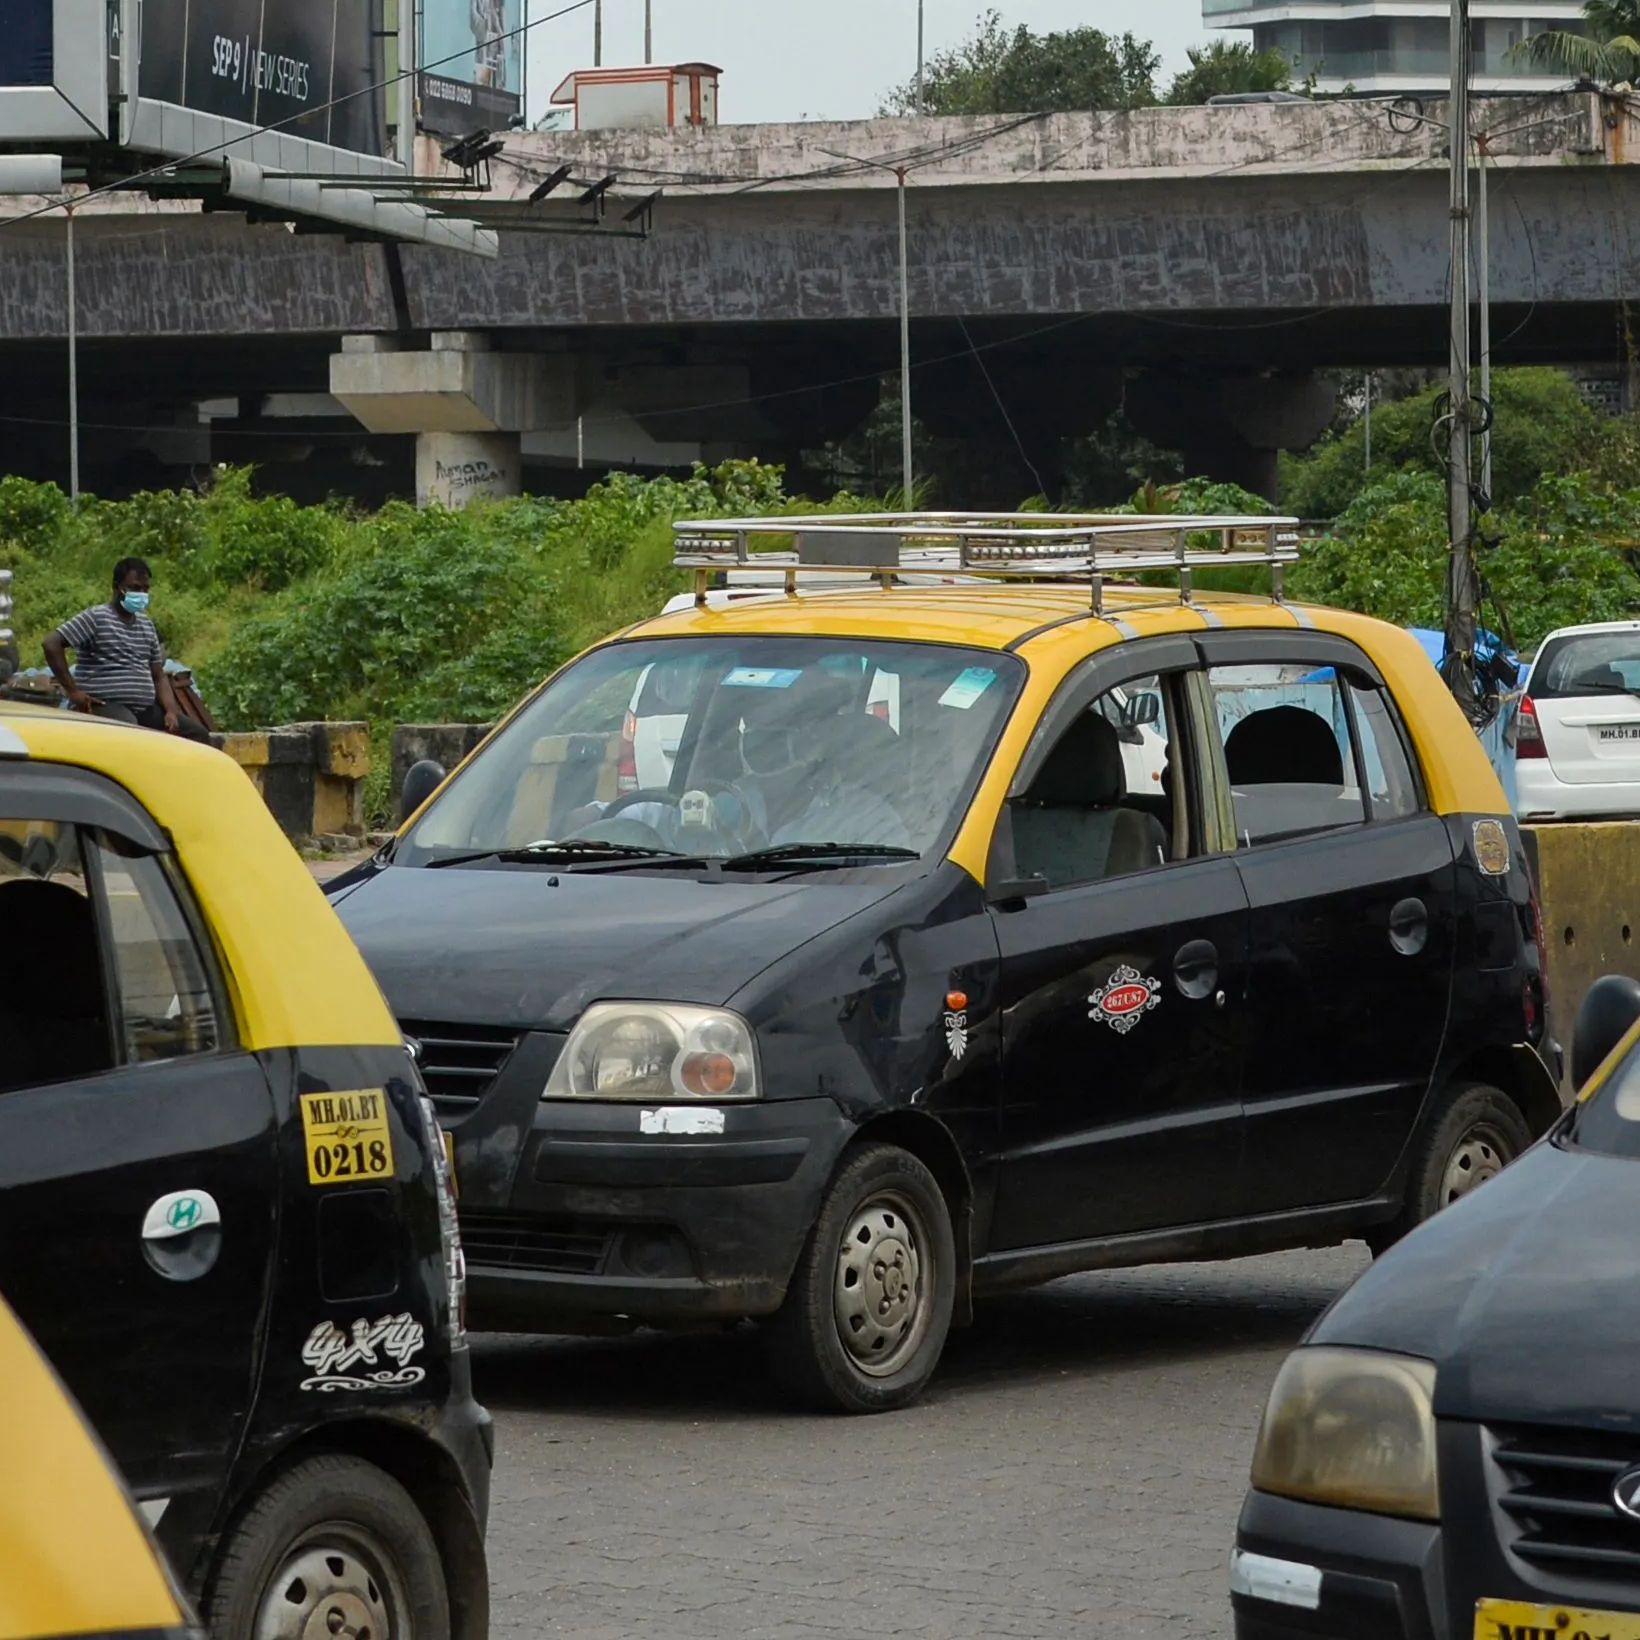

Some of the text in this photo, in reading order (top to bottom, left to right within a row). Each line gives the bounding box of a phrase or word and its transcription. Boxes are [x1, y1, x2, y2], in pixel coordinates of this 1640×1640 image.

[212, 35, 309, 100] SEP 9 NEW SERIES
[308, 1095, 379, 1125] MH.01.BT
[313, 1140, 387, 1178] 0218
